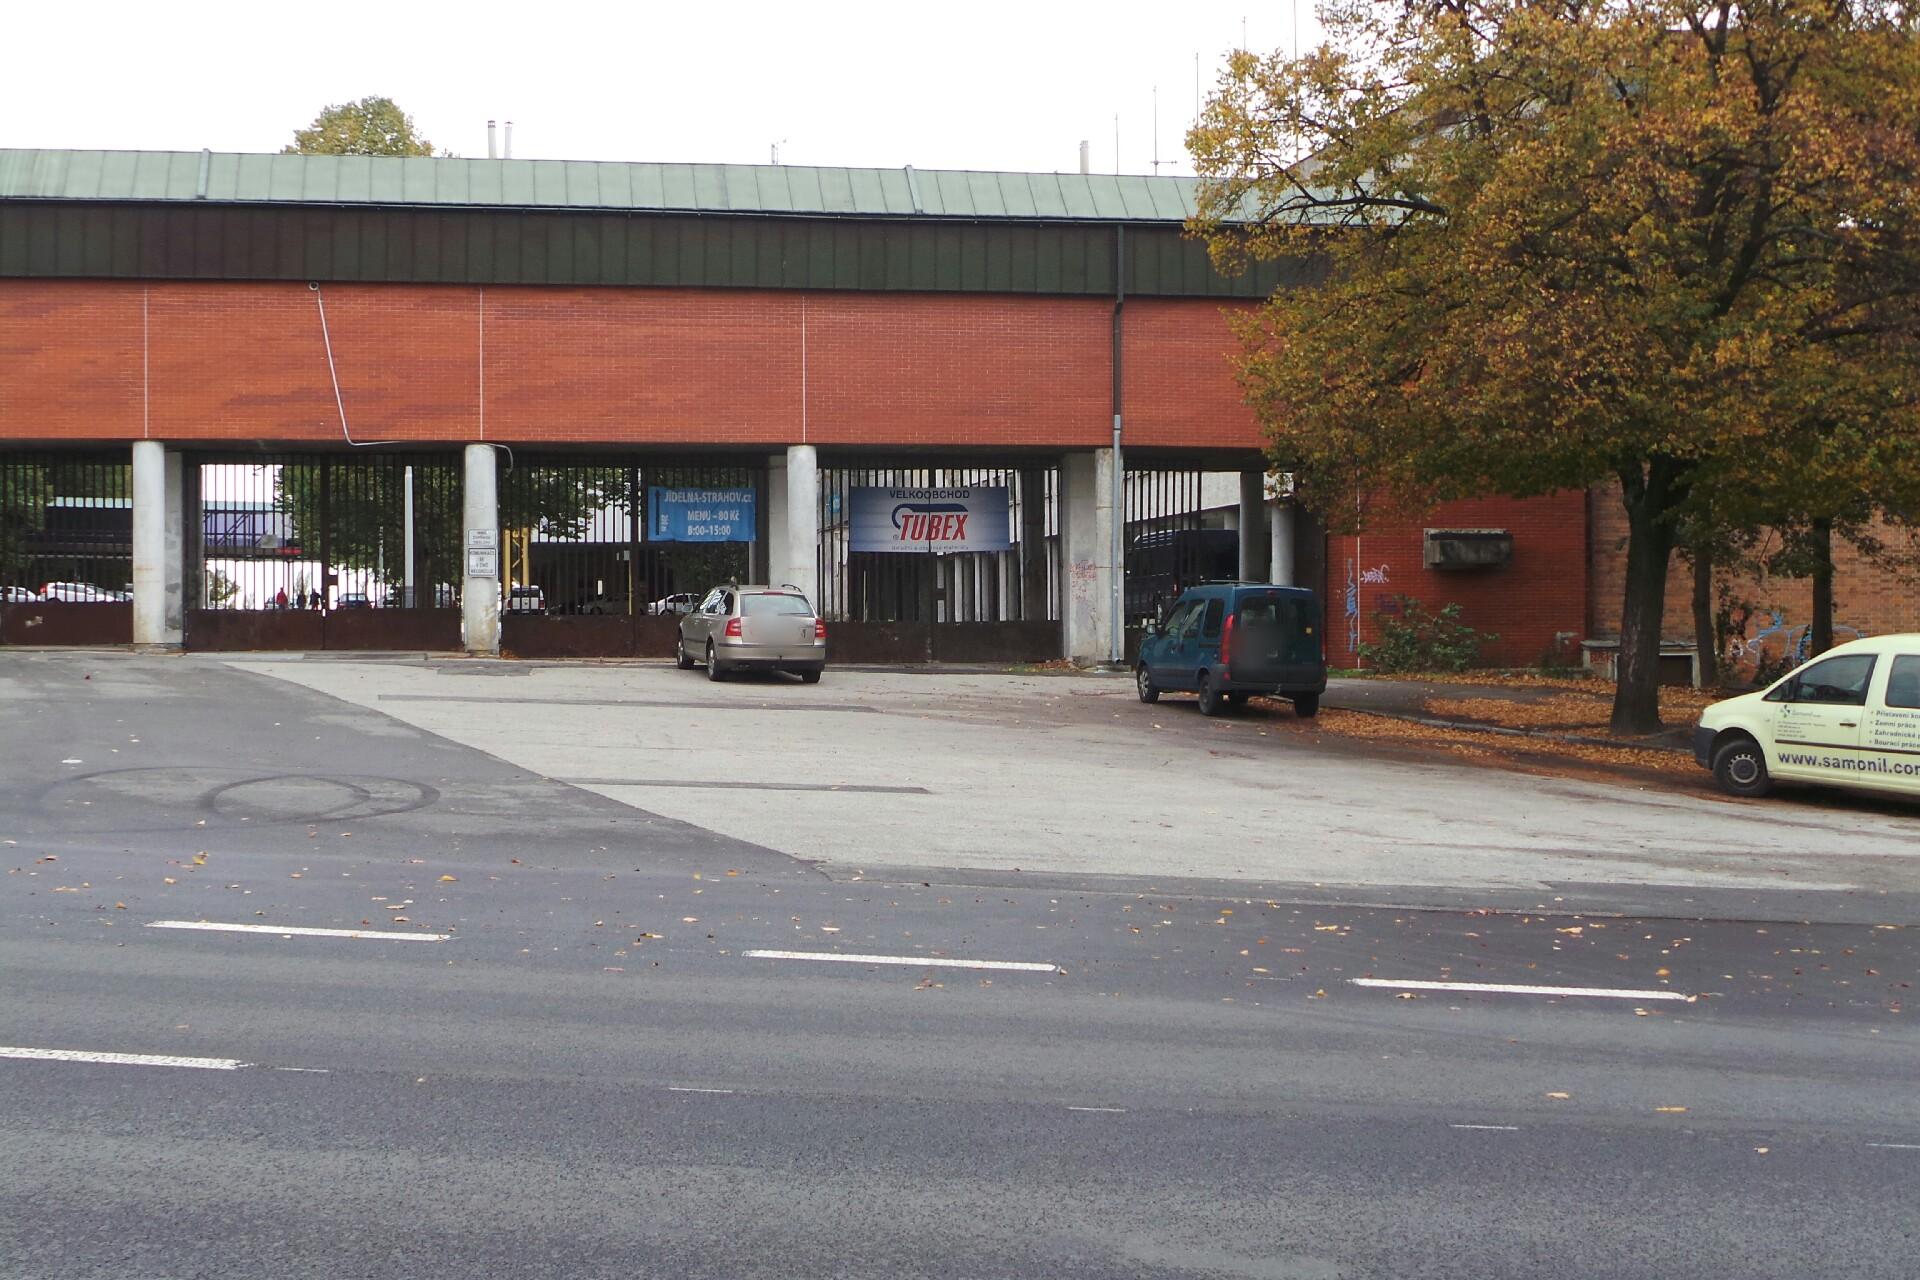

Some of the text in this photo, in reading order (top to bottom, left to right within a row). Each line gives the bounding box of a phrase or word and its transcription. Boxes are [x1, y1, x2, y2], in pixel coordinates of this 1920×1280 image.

[890, 489, 970, 499] VELKOOBCHOD
[687, 510, 711, 521] MENU
[900, 514, 968, 541] TUBEX
